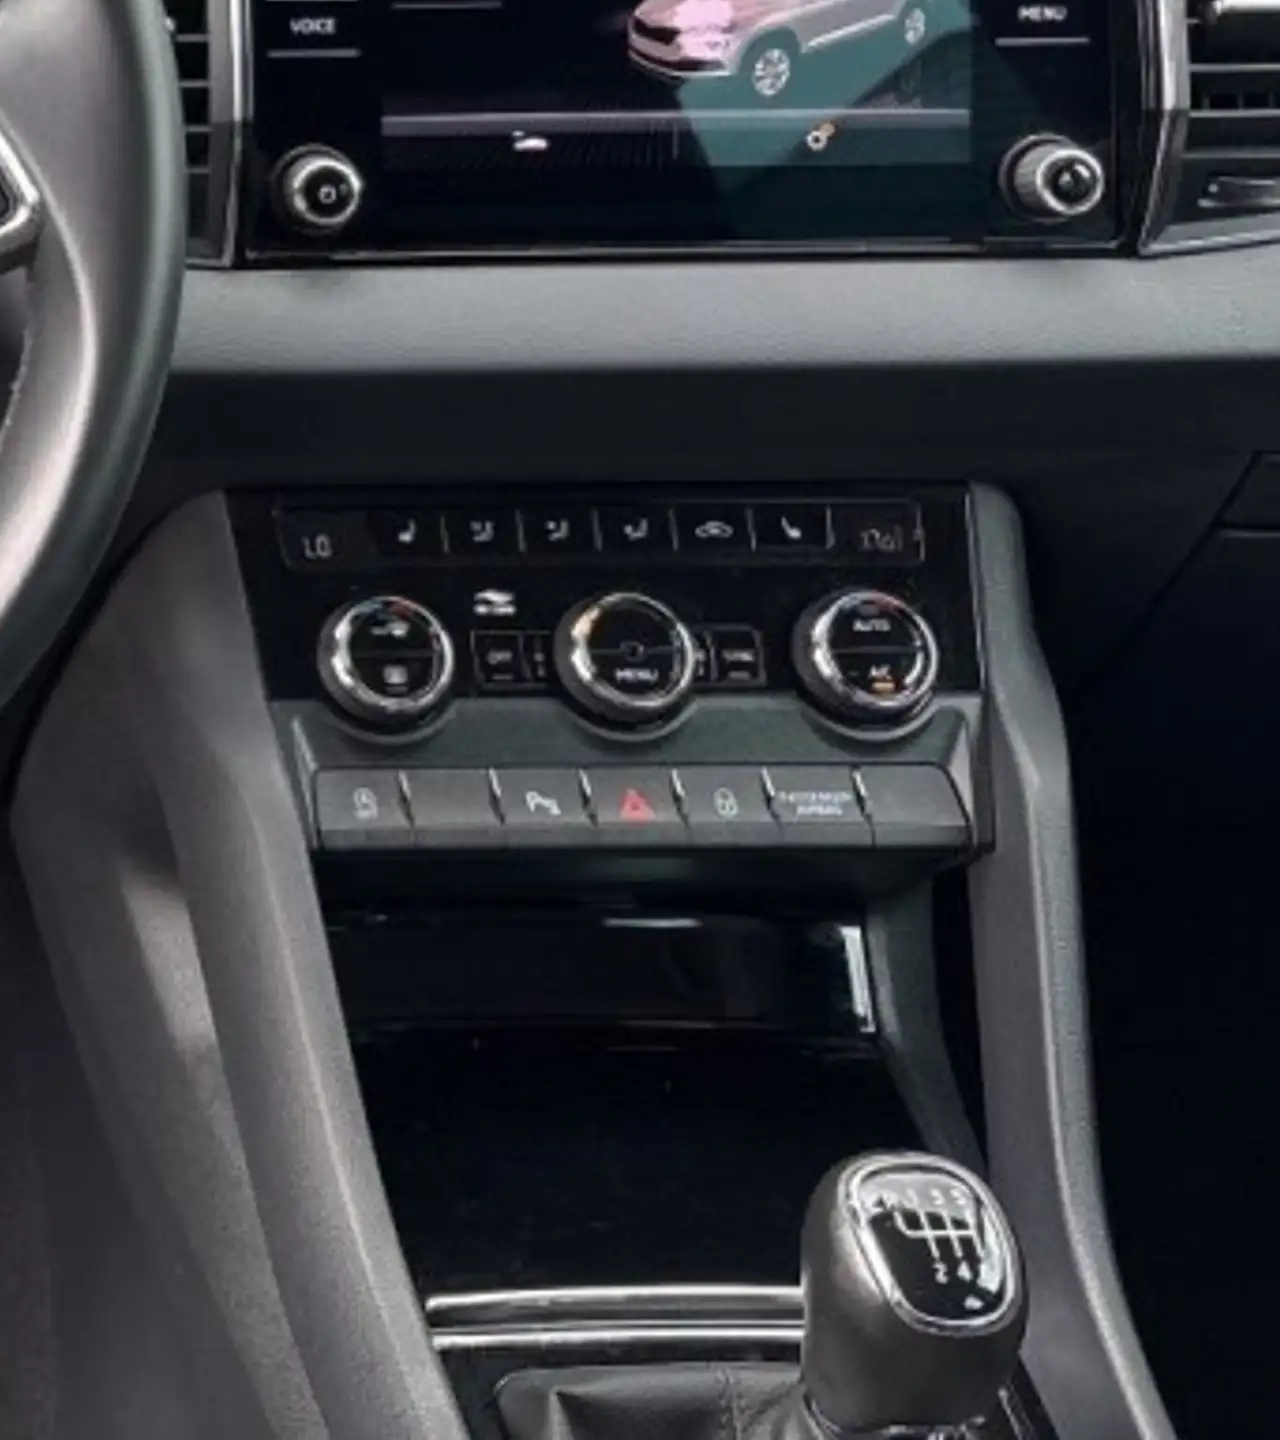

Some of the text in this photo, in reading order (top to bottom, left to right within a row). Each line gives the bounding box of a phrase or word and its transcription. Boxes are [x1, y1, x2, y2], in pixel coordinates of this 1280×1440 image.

[1017, 5, 1068, 21] MENU
[290, 17, 337, 35] VOICE
[615, 666, 659, 682] MENU
